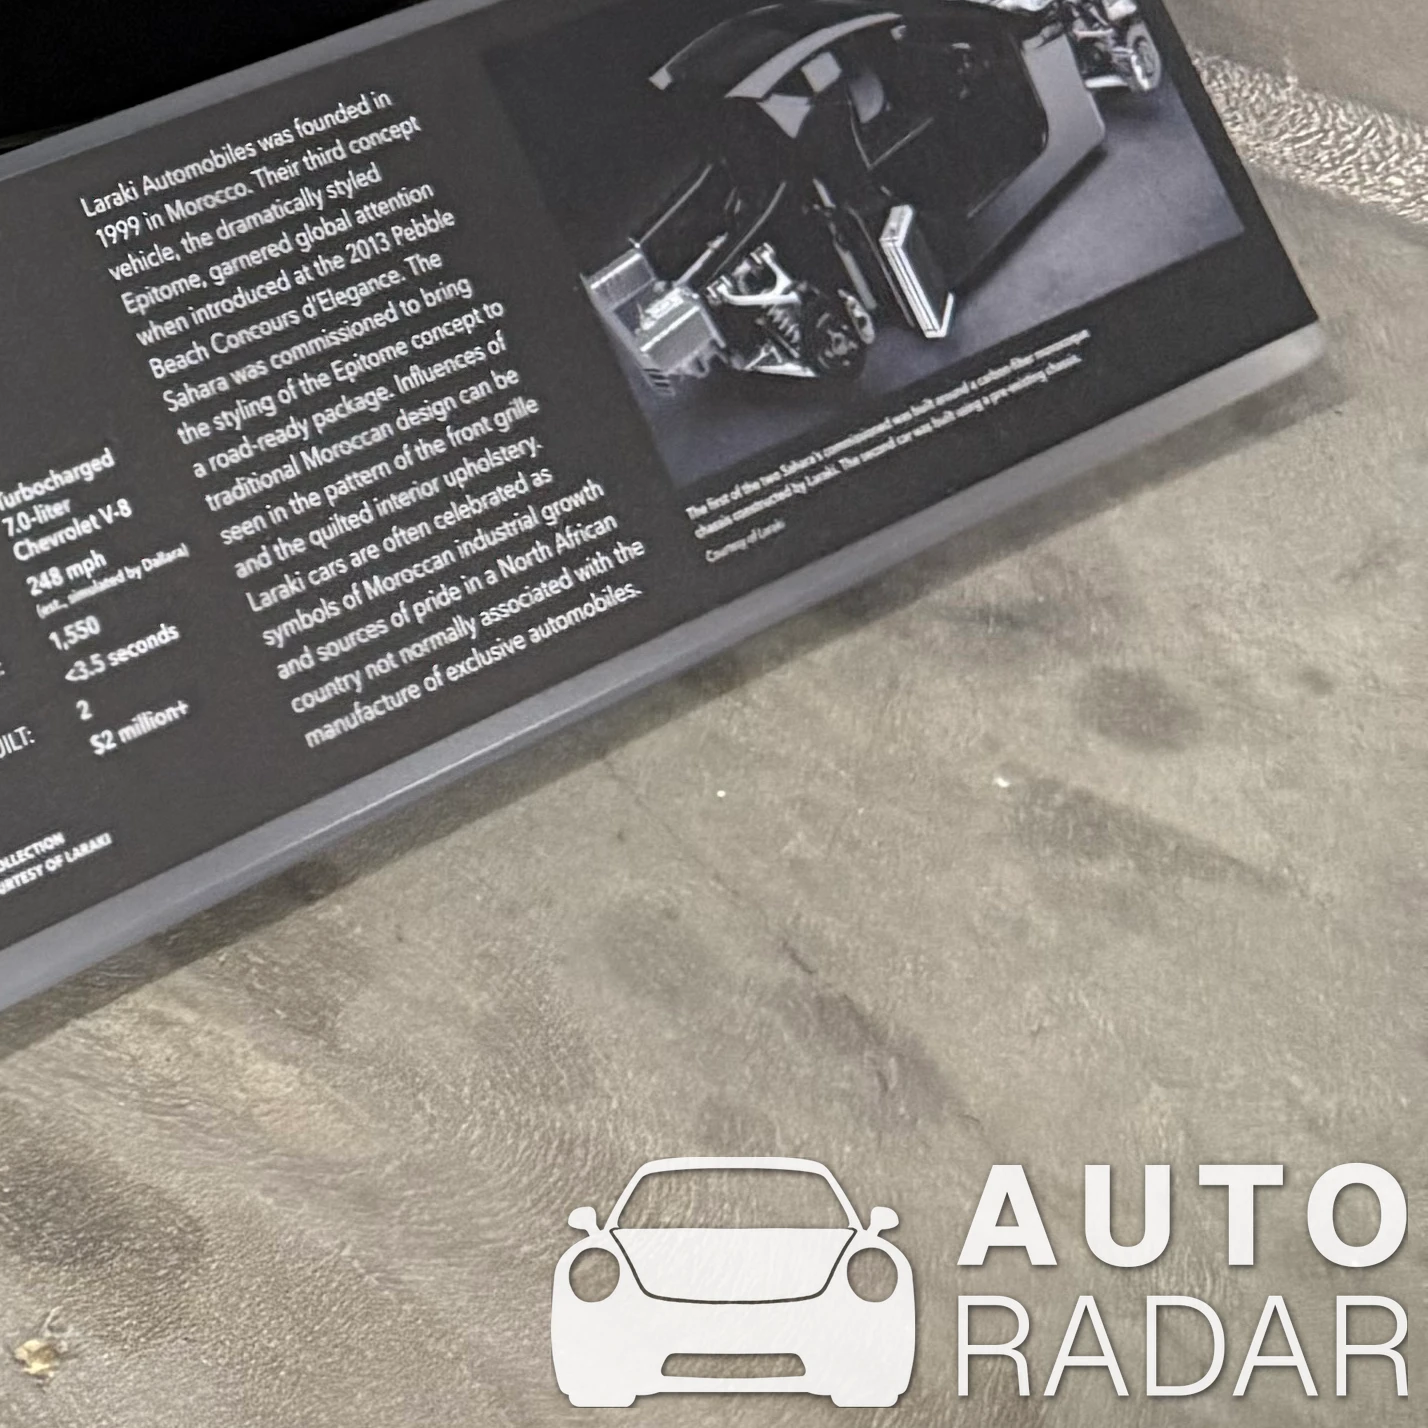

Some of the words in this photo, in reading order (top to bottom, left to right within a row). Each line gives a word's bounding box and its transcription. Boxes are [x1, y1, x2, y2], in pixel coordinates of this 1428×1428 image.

[79, 180, 140, 218] Laraki
[142, 142, 257, 196] Automobiles
[256, 128, 295, 152] was
[293, 93, 373, 138] founded
[370, 91, 393, 110] in
[95, 215, 141, 248] 1999
[142, 211, 166, 231] in
[163, 182, 254, 223] Morocco.
[249, 158, 300, 188] Their
[301, 138, 348, 171] third
[348, 115, 422, 154] concept
[108, 243, 181, 281] vehicle,
[180, 231, 214, 255] the
[215, 186, 324, 240] dramatically
[325, 161, 383, 199] styled
[120, 273, 208, 316] Epitome,
[208, 231, 294, 287] garnered
[294, 208, 353, 253] global
[354, 184, 435, 225] attention
[135, 315, 190, 346] when
[187, 268, 292, 325] introduced
[293, 264, 315, 285] at
[312, 254, 346, 277] the
[345, 231, 392, 264] 2013
[390, 208, 455, 246] Pebble
[148, 340, 210, 379] Beach
[210, 309, 301, 354] Concours
[301, 269, 407, 319] d'Elegance.
[403, 253, 443, 276] The
[162, 376, 230, 413] Sahara
[229, 359, 269, 385] was
[269, 300, 400, 370] commissioned
[398, 298, 422, 317] to
[419, 278, 473, 308] bring
[176, 421, 212, 445] the
[212, 395, 277, 431] styling
[277, 377, 298, 404] of
[298, 372, 332, 396] the
[330, 340, 409, 383] Epitome
[410, 307, 485, 350] concept
[482, 301, 504, 320] to
[192, 462, 208, 479] a
[207, 415, 309, 472] road-ready
[311, 386, 396, 434] package.
[393, 346, 487, 394] Influences
[487, 329, 507, 355] of
[204, 454, 302, 512] traditional
[299, 422, 395, 471] Moroccan
[395, 396, 458, 431] design
[458, 380, 493, 405] can
[490, 369, 520, 390] be
[1, 499, 71, 537] 7.0-liter
[12, 513, 102, 561] Chevrolet
[97, 498, 133, 525] V-8
[219, 514, 268, 545] seen
[265, 504, 289, 525] in
[287, 491, 322, 515] the
[323, 461, 393, 507] pattern
[393, 443, 414, 471] of
[413, 438, 447, 461] the
[445, 416, 494, 448] front
[493, 396, 540, 433] grille
[234, 544, 273, 579] and
[272, 537, 307, 561] the
[308, 500, 375, 549] quilted
[372, 477, 440, 517] interior
[442, 436, 543, 489] upholstery.
[25, 566, 64, 597] 248
[65, 549, 108, 581] mph
[123, 565, 143, 580] by
[245, 571, 306, 612] Laraki
[307, 558, 349, 586] cars
[349, 543, 380, 568] are
[382, 521, 433, 553] often
[433, 471, 530, 530] celebrated
[530, 468, 553, 488] as
[262, 597, 341, 649] symbols
[342, 582, 363, 611] of
[361, 549, 457, 601] Moroccan
[453, 504, 541, 559] industrial
[540, 478, 605, 527] growth
[276, 645, 316, 680] and
[316, 618, 390, 662] sources
[390, 600, 411, 628] of
[412, 583, 463, 624] pride
[459, 575, 484, 595] in
[483, 569, 499, 586] a
[496, 539, 554, 579] North
[555, 515, 618, 555] African
[48, 615, 101, 651] 1,550
[64, 653, 106, 682] <3.5
[106, 622, 180, 667] seconds
[291, 669, 363, 713] country
[364, 651, 399, 680] not
[398, 614, 477, 664] normally
[479, 566, 574, 627] associated
[573, 551, 615, 582] with
[612, 541, 646, 565] the
[304, 683, 422, 748] manufacture
[423, 664, 444, 692] of
[445, 634, 527, 682] exclusive
[527, 583, 643, 644] automobiles.
[75, 699, 94, 721] 2
[89, 729, 117, 756] $2
[117, 700, 189, 744] million+
[44, 854, 64, 872] OF
[63, 832, 113, 863] LARAKI
